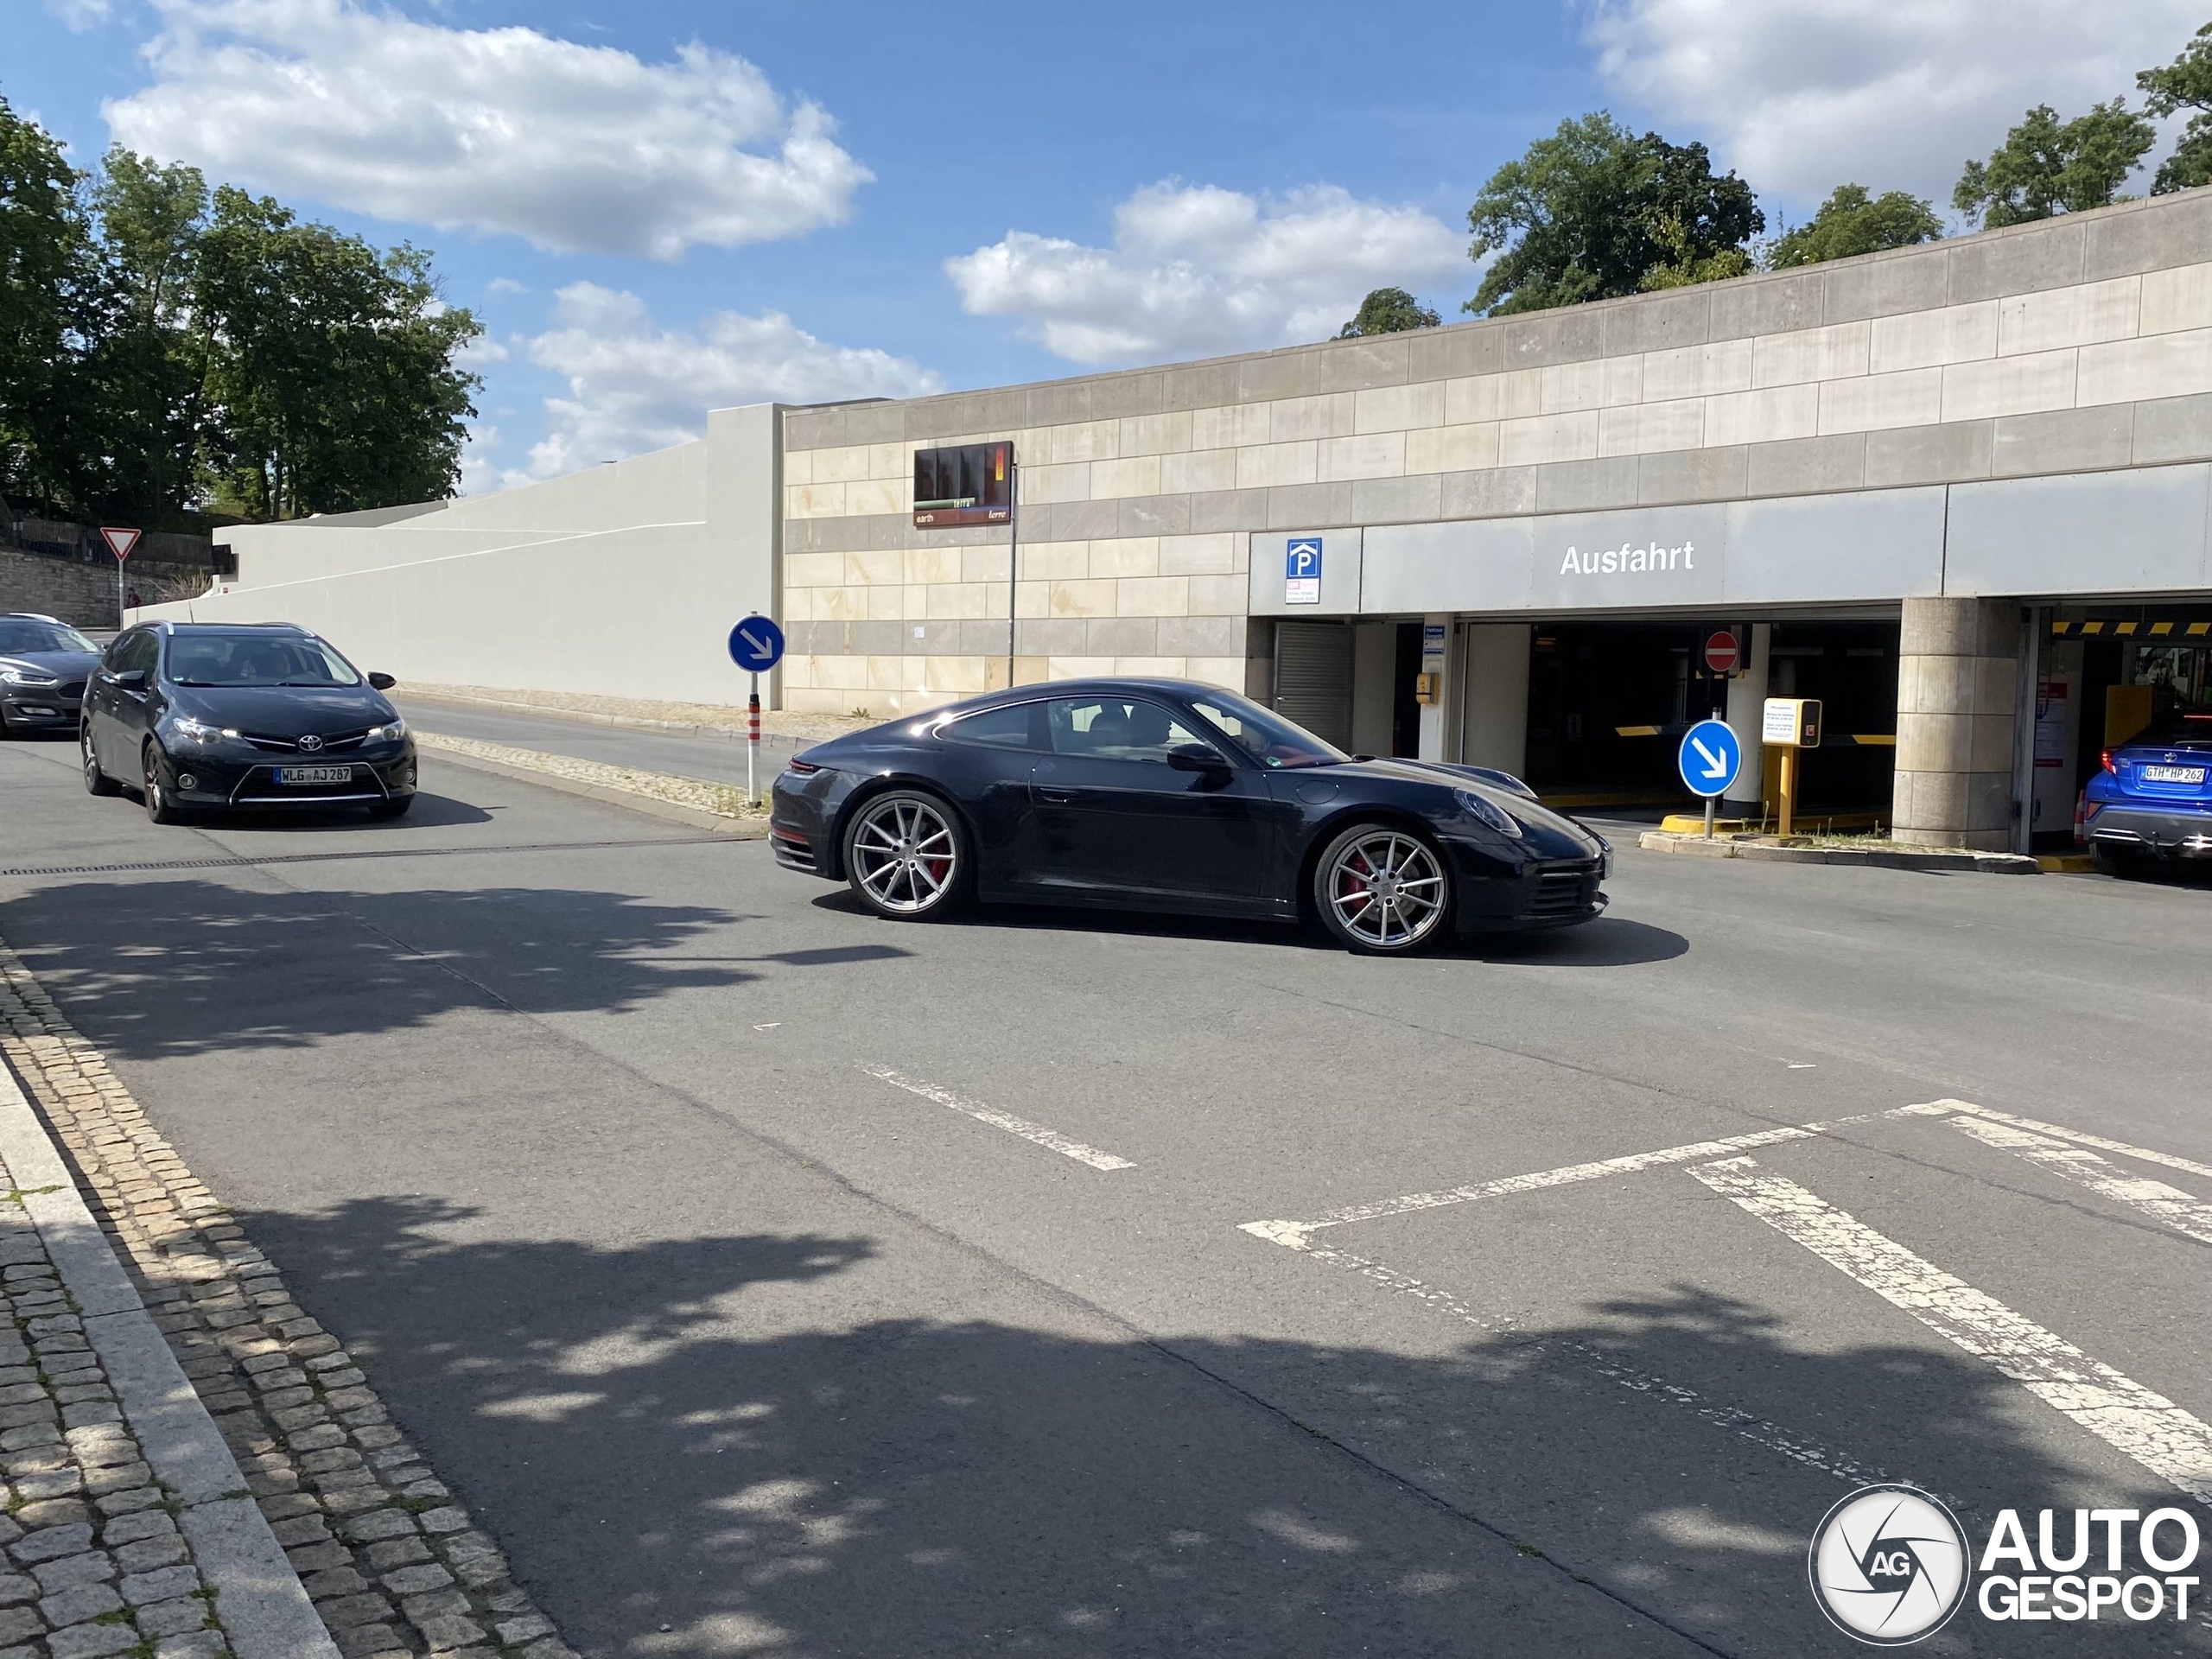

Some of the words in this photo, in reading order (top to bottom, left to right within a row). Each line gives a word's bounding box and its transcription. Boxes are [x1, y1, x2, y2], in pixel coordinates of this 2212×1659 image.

[953, 499, 970, 508] terra
[916, 513, 934, 523] earth
[988, 510, 1007, 519] terre
[1297, 552, 1312, 575] P
[1560, 540, 1694, 575] Ausfahrt
[282, 769, 304, 781] WLG
[313, 769, 327, 781] AJ
[329, 768, 350, 780] 287
[2146, 766, 2165, 778] GTH
[2170, 768, 2183, 779] HP
[2184, 769, 2203, 780] 262
